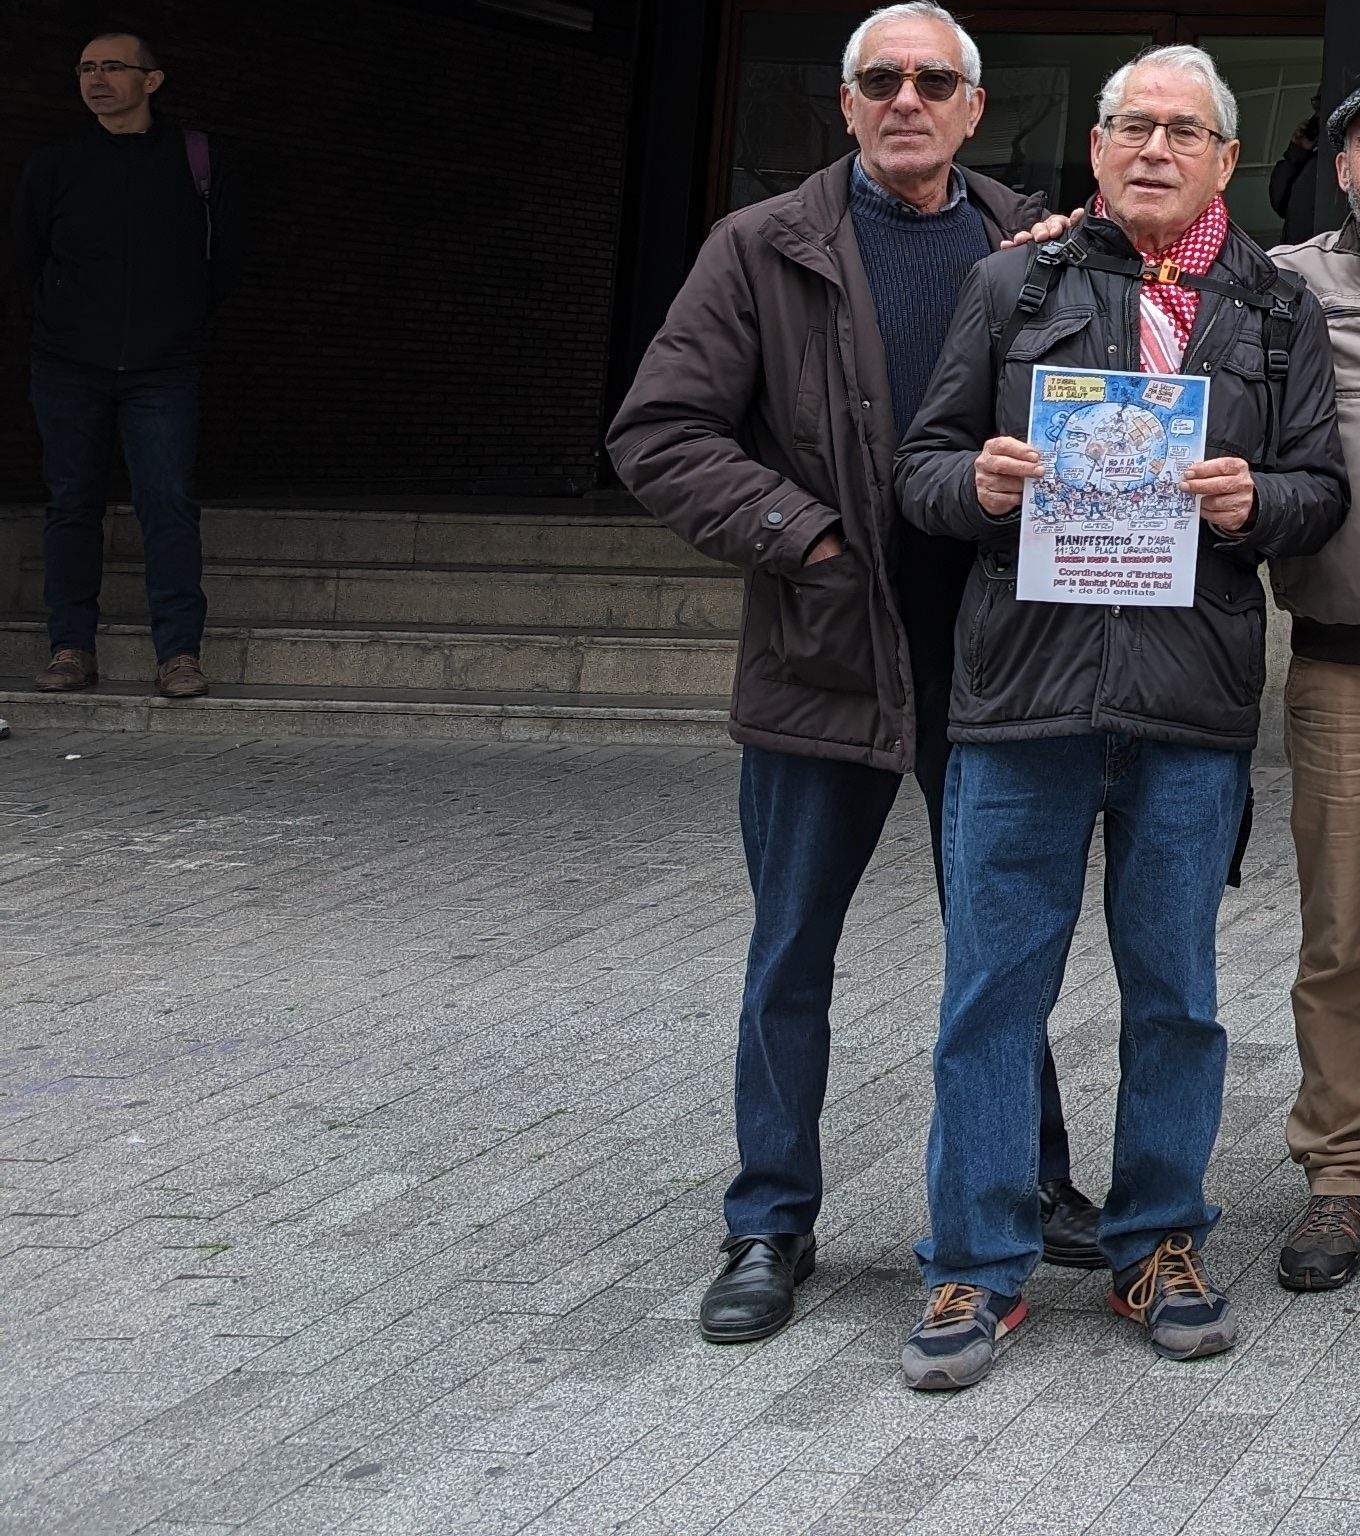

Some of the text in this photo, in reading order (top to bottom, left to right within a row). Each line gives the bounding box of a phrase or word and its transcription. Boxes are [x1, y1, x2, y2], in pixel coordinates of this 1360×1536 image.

[1055, 534, 1131, 546] MANIFESTACIÓ
[1137, 535, 1145, 545] 7
[1059, 568, 1124, 578] Coordinadora
[1053, 579, 1066, 587] per
[1079, 579, 1107, 587] Sanitat
[1110, 579, 1138, 588] Pública
[1153, 581, 1172, 589] Rubí
